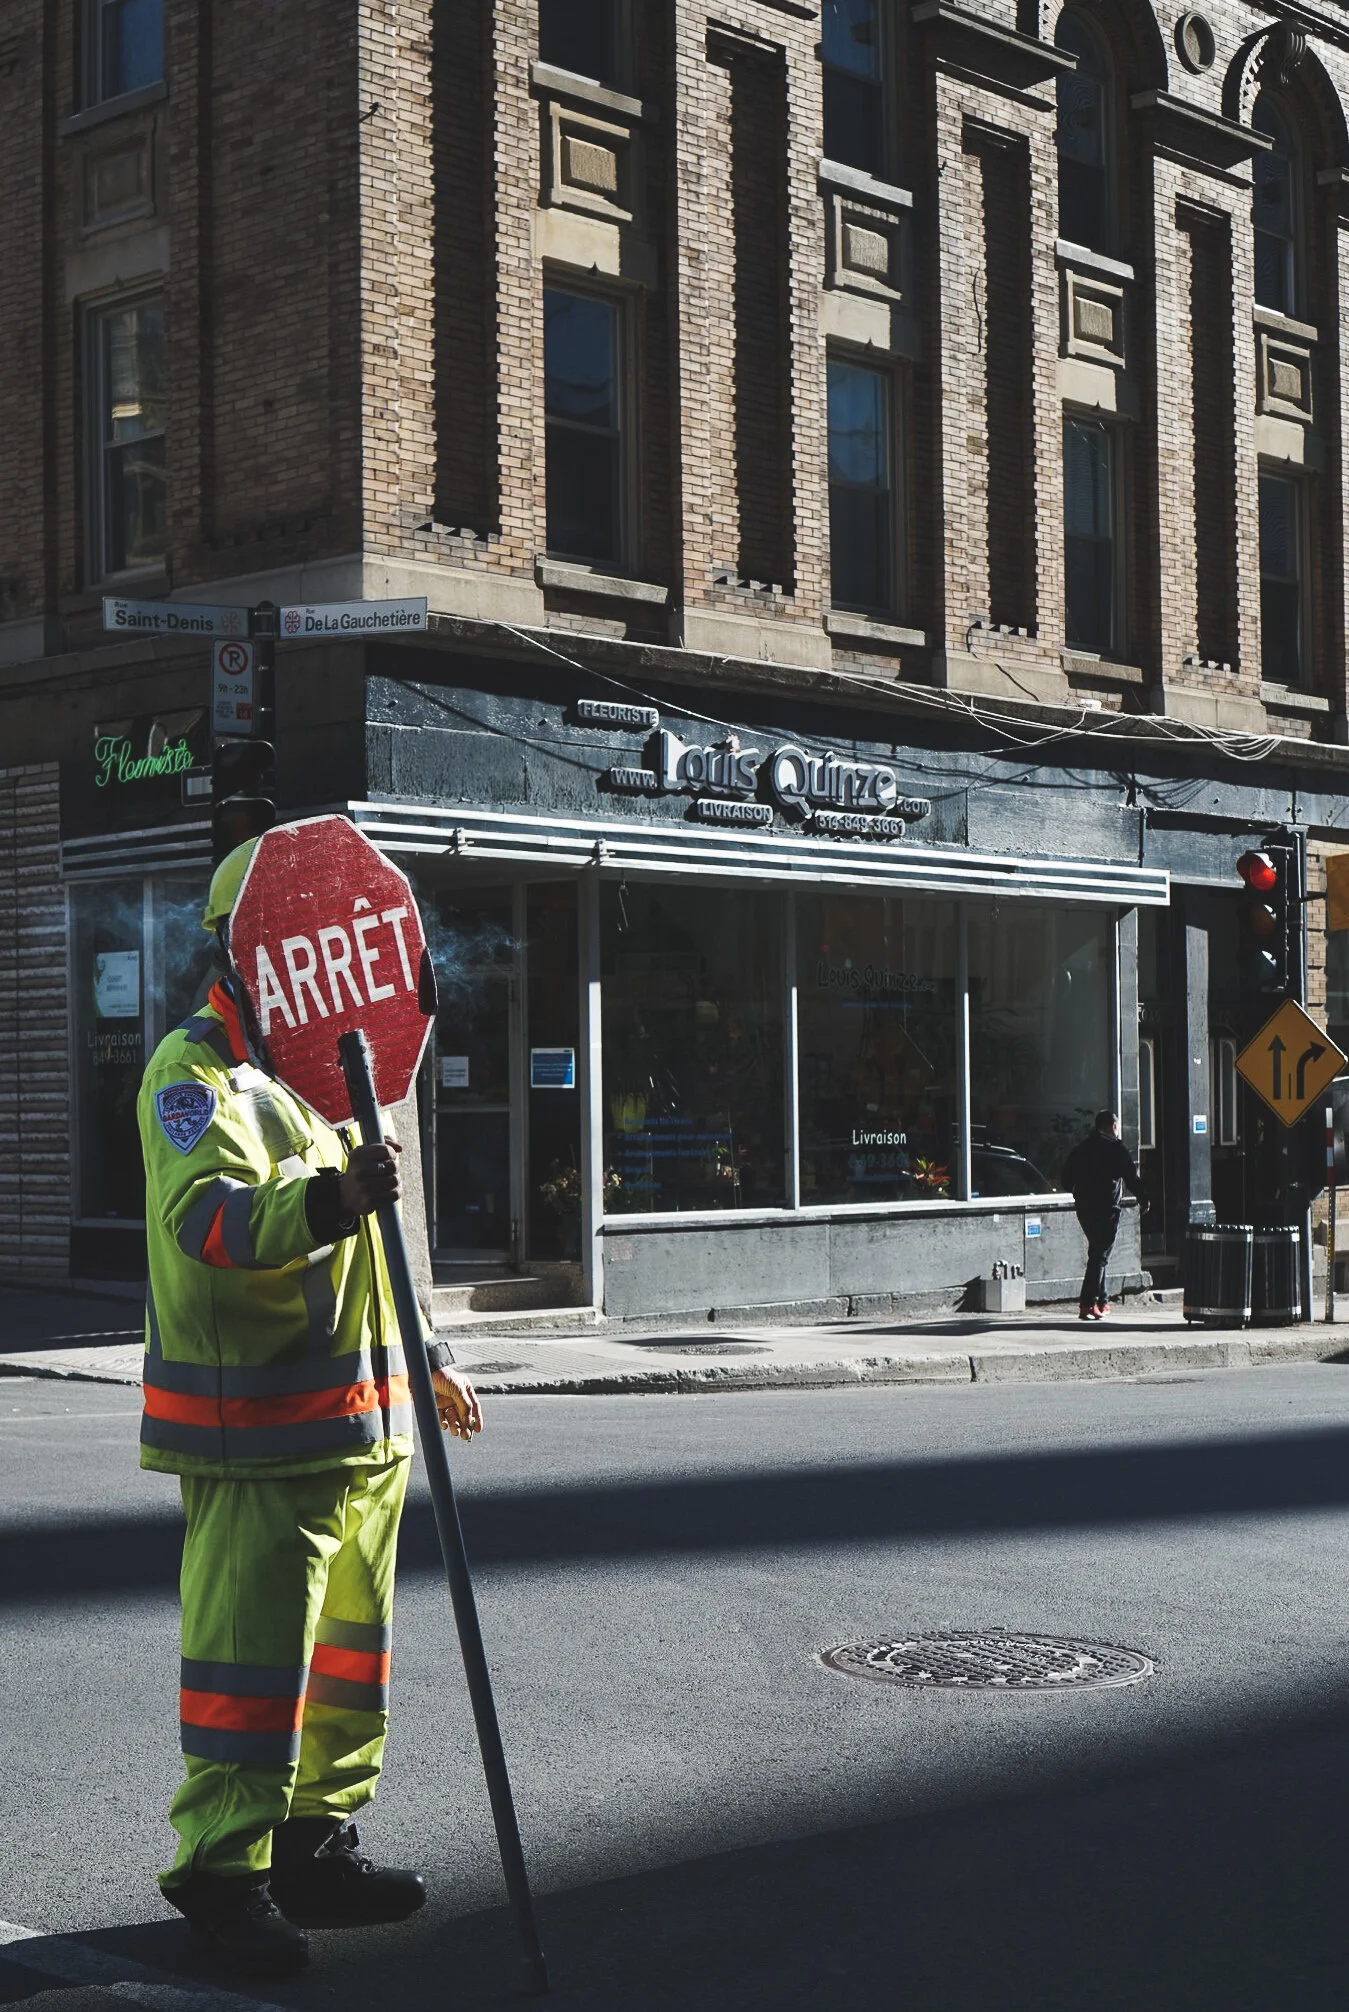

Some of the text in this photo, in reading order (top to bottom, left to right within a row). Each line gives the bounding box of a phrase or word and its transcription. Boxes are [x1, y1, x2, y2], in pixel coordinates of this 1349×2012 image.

[115, 610, 214, 631] Saint-Denis
[583, 703, 657, 724] FLEURISTE
[660, 729, 758, 793] Louis
[771, 743, 896, 819] Quinze
[702, 802, 771, 821] LIVRAISON
[819, 814, 902, 835] 514-849-3661
[255, 897, 415, 1037] ARRÊT
[87, 1030, 142, 1048] Livraison
[852, 1128, 907, 1145] Livraison
